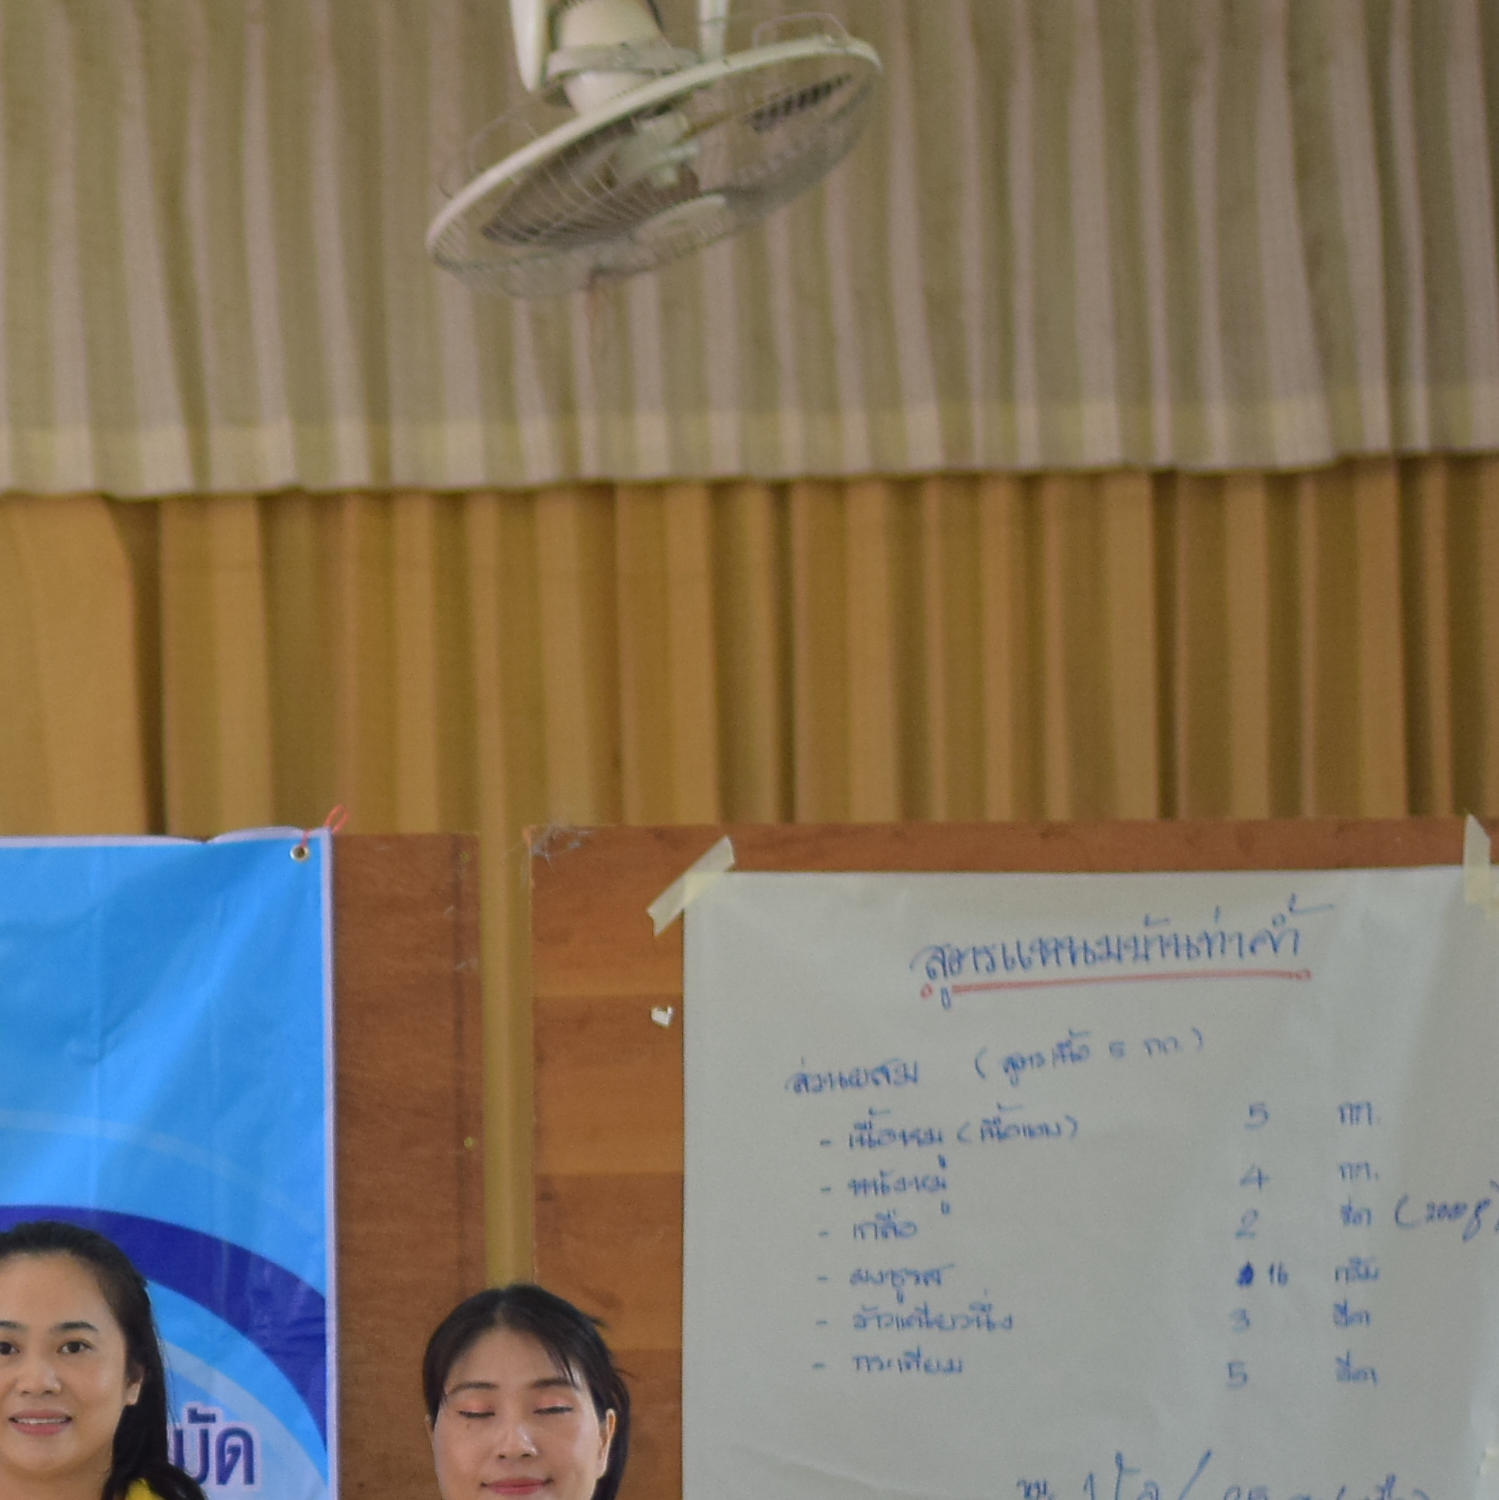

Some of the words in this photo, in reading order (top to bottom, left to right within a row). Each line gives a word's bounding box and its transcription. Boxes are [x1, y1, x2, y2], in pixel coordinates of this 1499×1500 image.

[1243, 1101, 1270, 1130] 5
[1239, 1164, 1270, 1191] 4
[1234, 1207, 1259, 1240] 2
[1229, 1307, 1251, 1334] 3
[1226, 1360, 1249, 1389] 5
